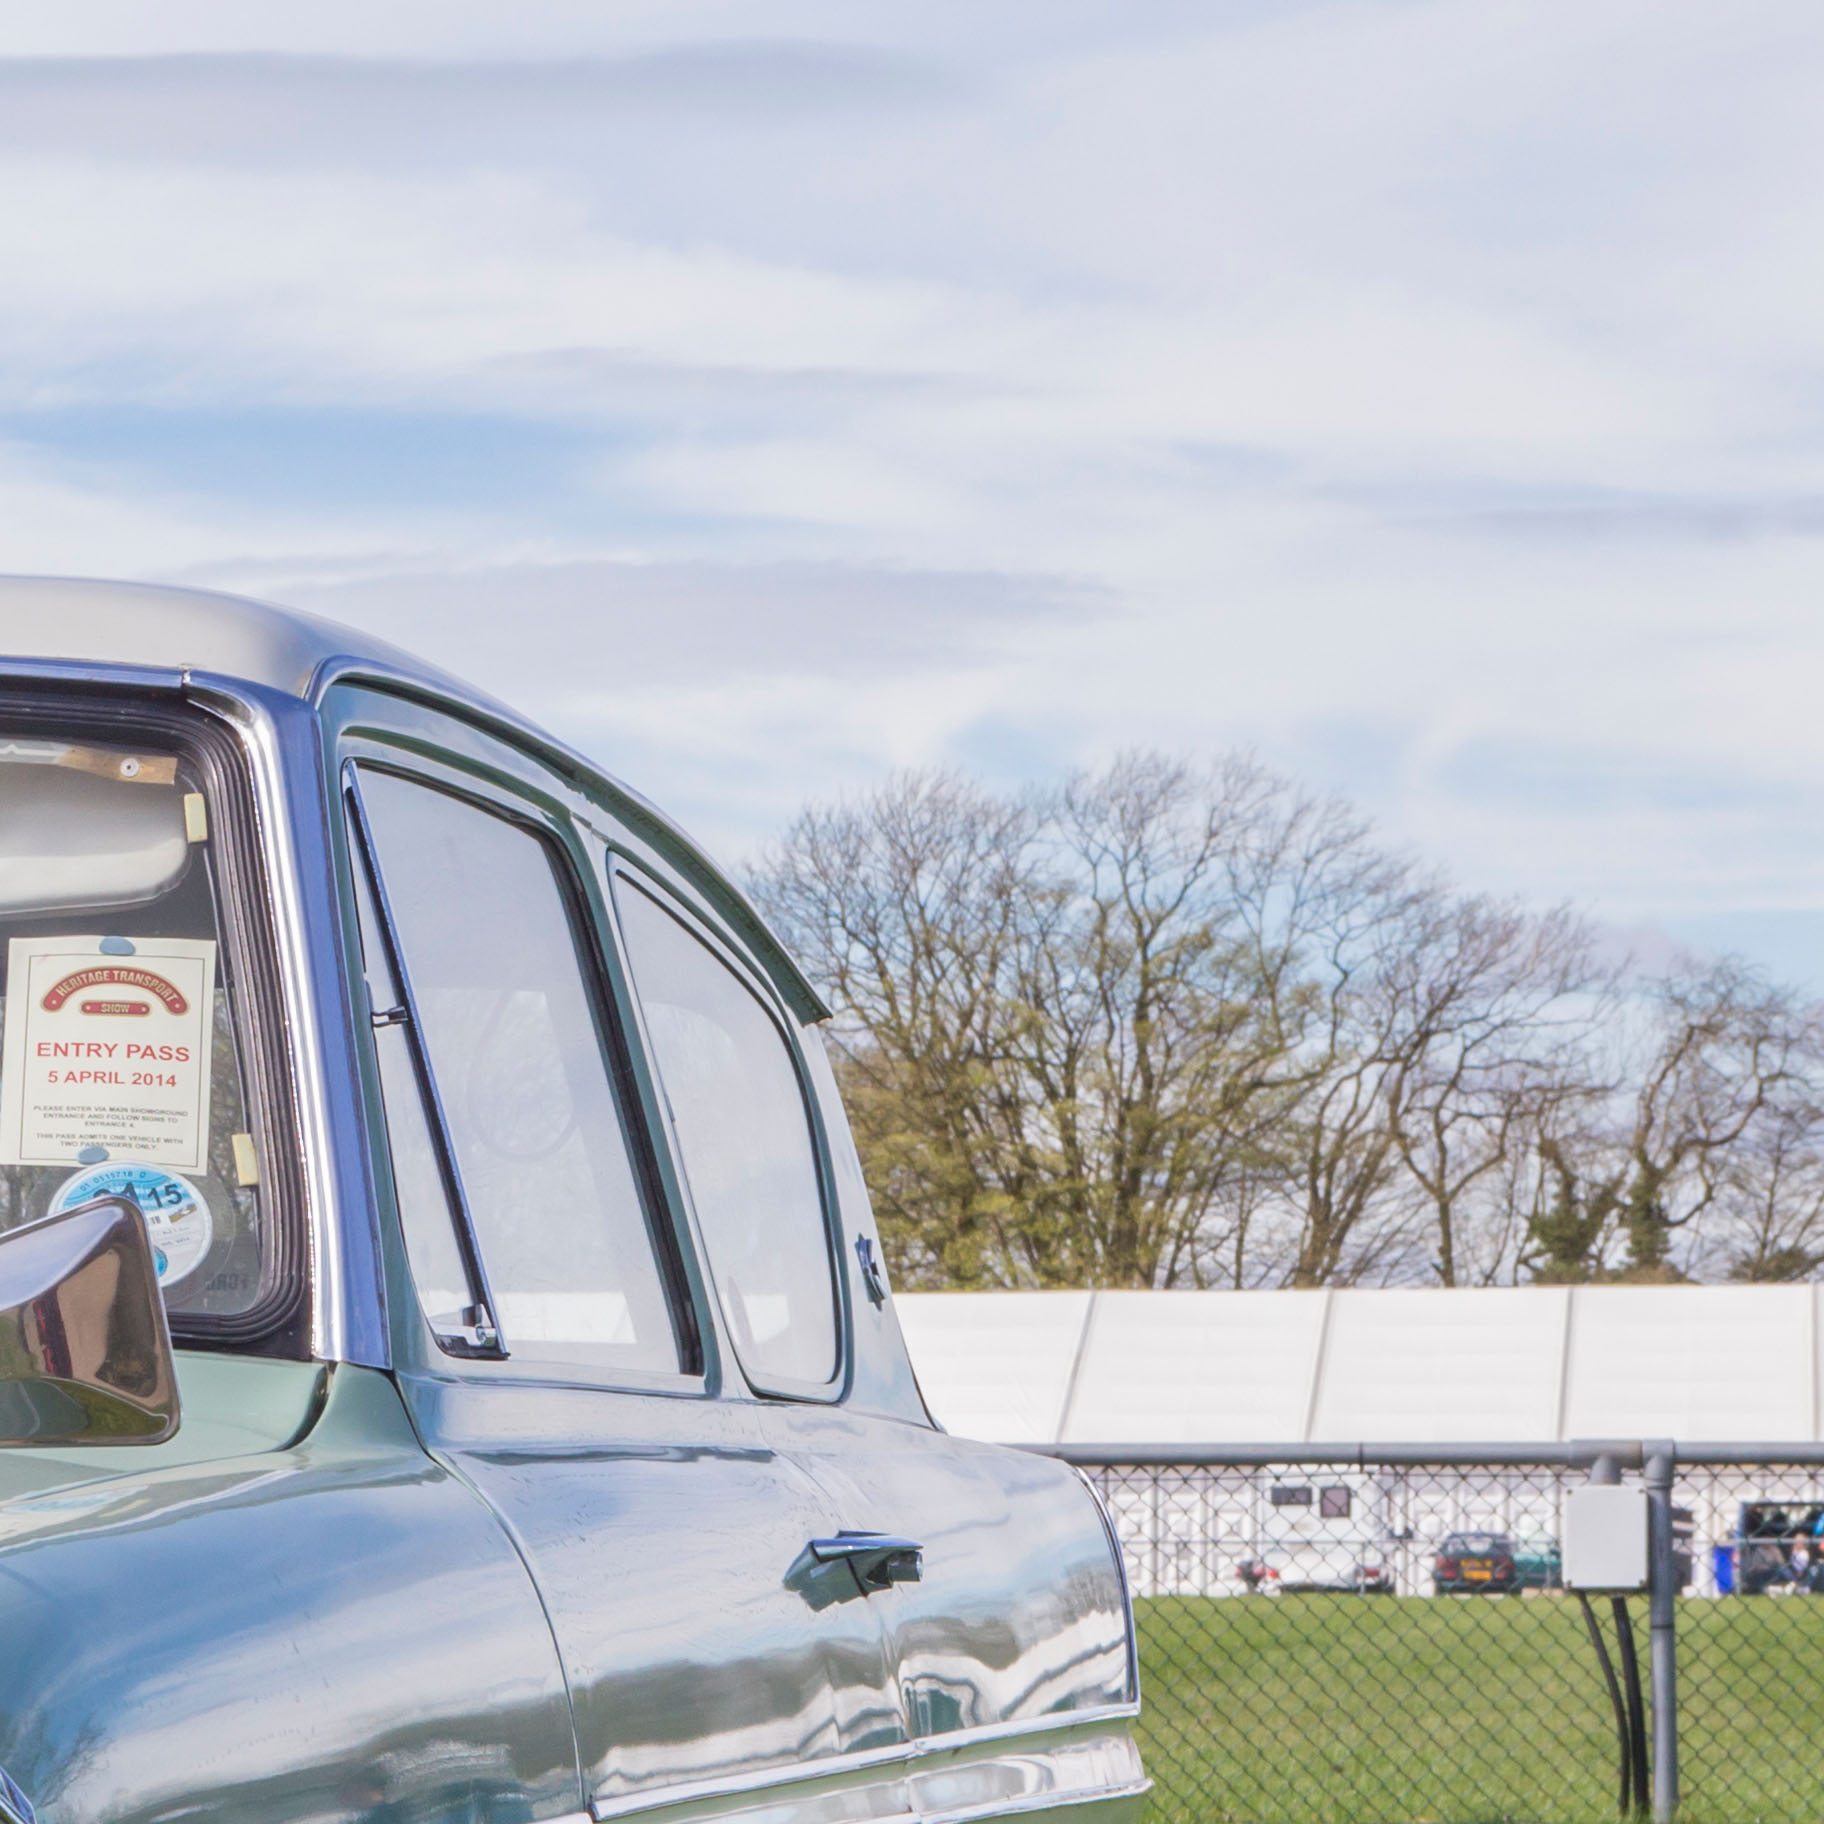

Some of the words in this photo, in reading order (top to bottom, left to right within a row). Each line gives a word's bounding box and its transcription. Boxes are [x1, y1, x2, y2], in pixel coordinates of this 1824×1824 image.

[55, 970, 109, 997] HERITAGE
[113, 970, 178, 1002] TRANSPORT
[101, 1003, 130, 1013] SHOW
[37, 1042, 118, 1058] ENTRY
[126, 1043, 190, 1062] PASS
[48, 1070, 58, 1084] 5
[63, 1070, 125, 1085] APRIL
[131, 1072, 177, 1088] 2014
[43, 1112, 85, 1120] ENTRANCE
[106, 1113, 140, 1121] FOLLOW
[66, 1105, 92, 1113] ENTER
[109, 1106, 129, 1114] MAIN
[131, 1107, 189, 1117] SHOWGROUND
[84, 1120, 127, 1128] ENTRANCE
[78, 1133, 108, 1141] ADMITS
[109, 1134, 127, 1142] ONE
[128, 1135, 162, 1144] VEHICLE
[80, 1141, 134, 1150] PASSENGERS
[147, 1183, 183, 1208] 15
